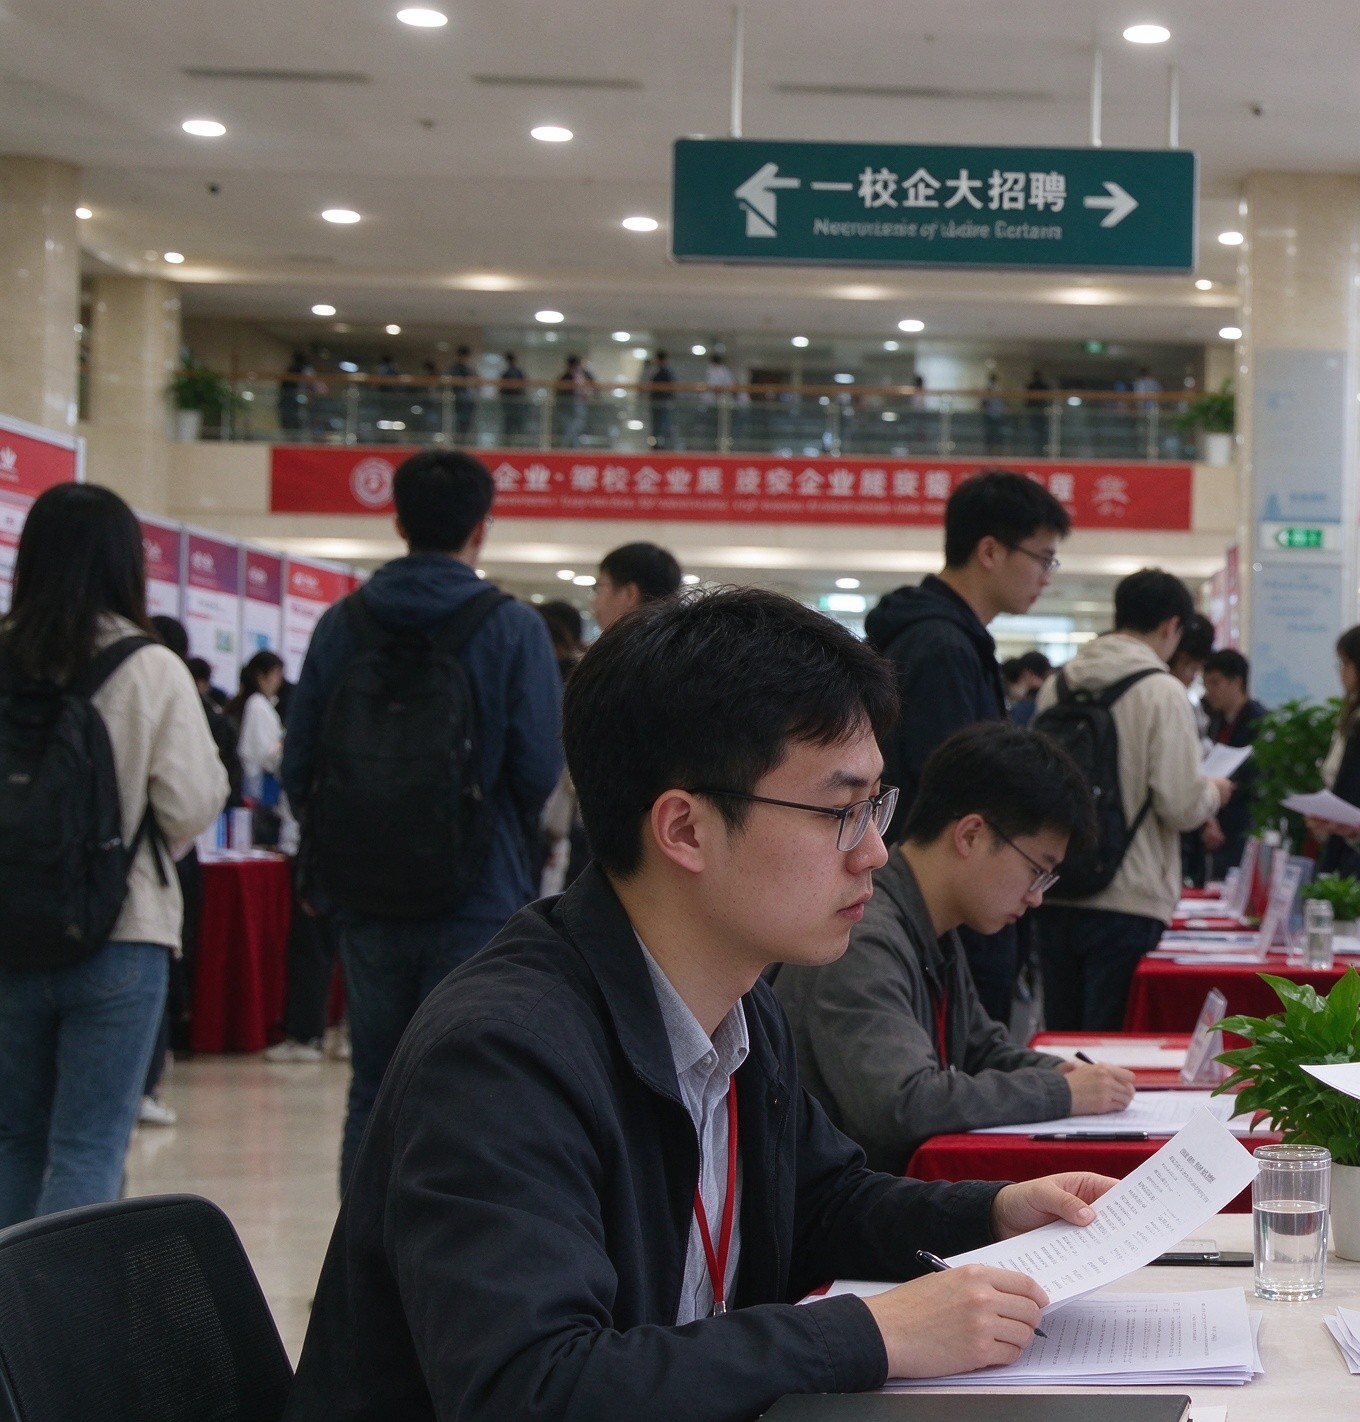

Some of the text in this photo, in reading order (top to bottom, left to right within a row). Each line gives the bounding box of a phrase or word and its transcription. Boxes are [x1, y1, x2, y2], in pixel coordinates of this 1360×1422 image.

[810, 166, 1067, 212] 一校企大招聘
